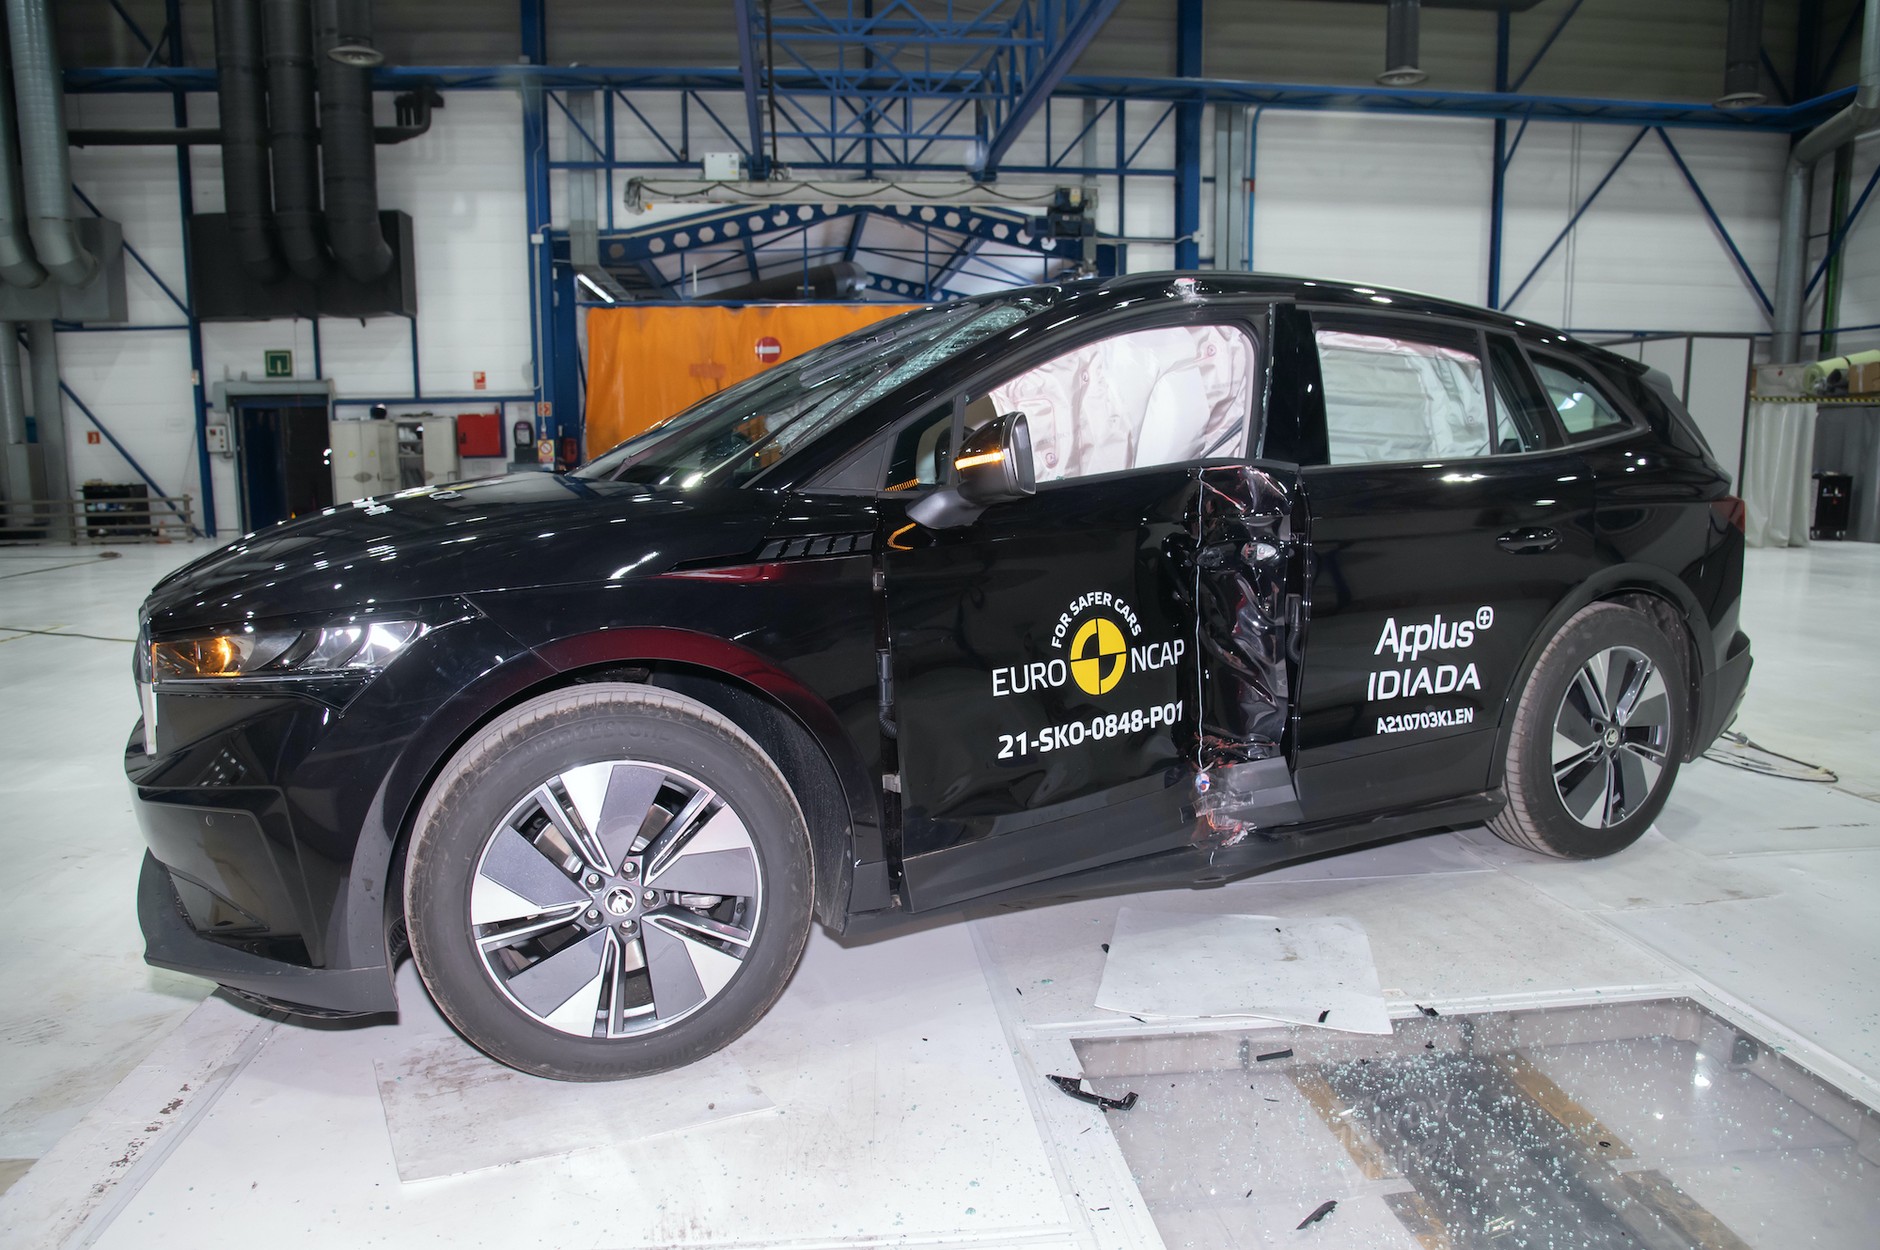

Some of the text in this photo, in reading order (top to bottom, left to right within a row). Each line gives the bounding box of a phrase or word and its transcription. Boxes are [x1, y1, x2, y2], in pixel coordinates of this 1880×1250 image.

[1051, 591, 1142, 648] FOR SAFER CARS
[991, 638, 1185, 697] EURO NCAP
[1367, 662, 1481, 701] IDIADA
[997, 700, 1184, 759] 21-SKO-0848-P01
